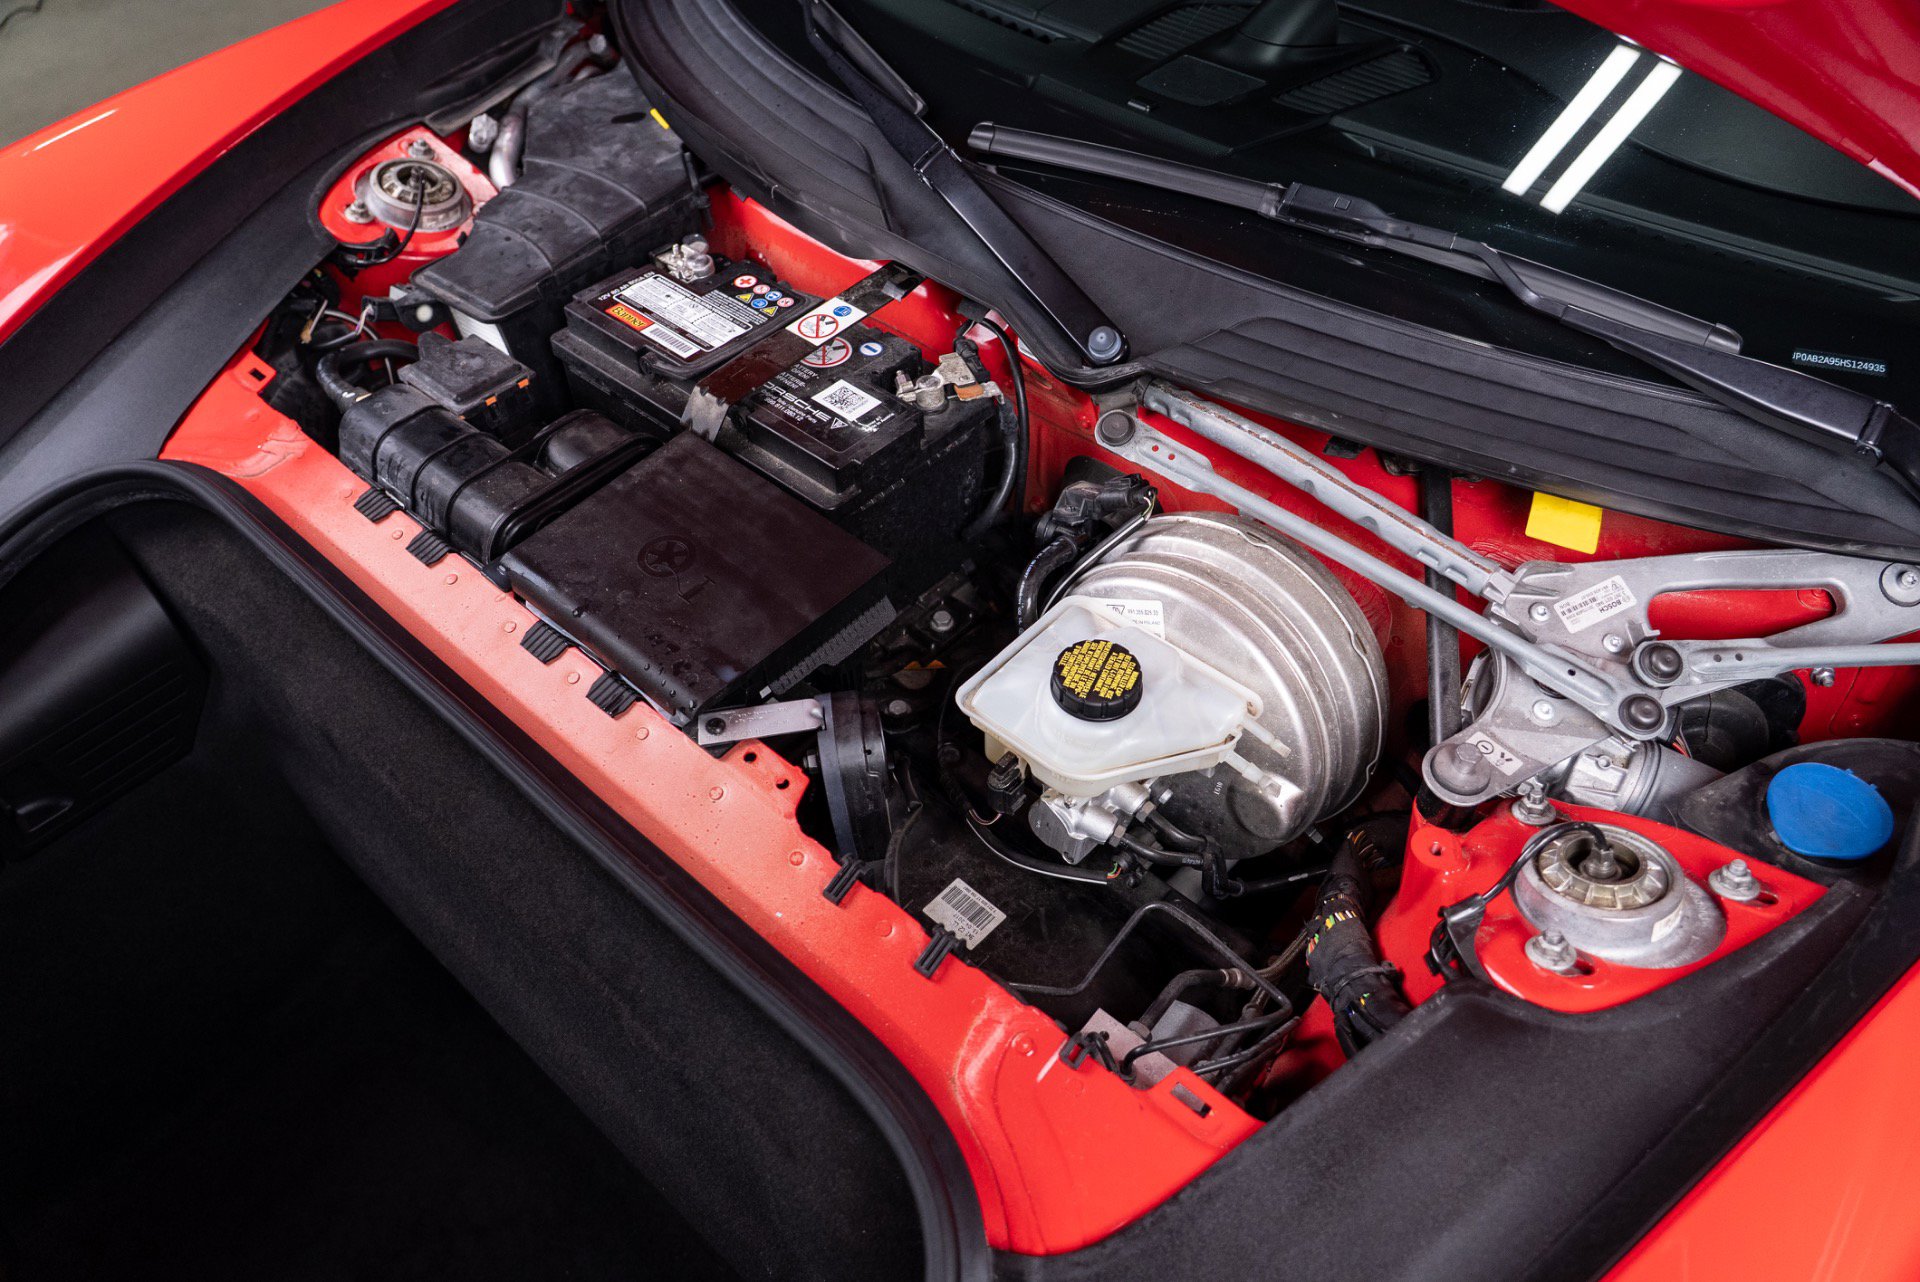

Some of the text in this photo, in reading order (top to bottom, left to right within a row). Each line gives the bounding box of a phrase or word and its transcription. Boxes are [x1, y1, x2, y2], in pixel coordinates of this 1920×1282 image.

[612, 306, 646, 328] Banner
[763, 380, 832, 422] ORSCHE
[1598, 599, 1622, 614] BOSCH
